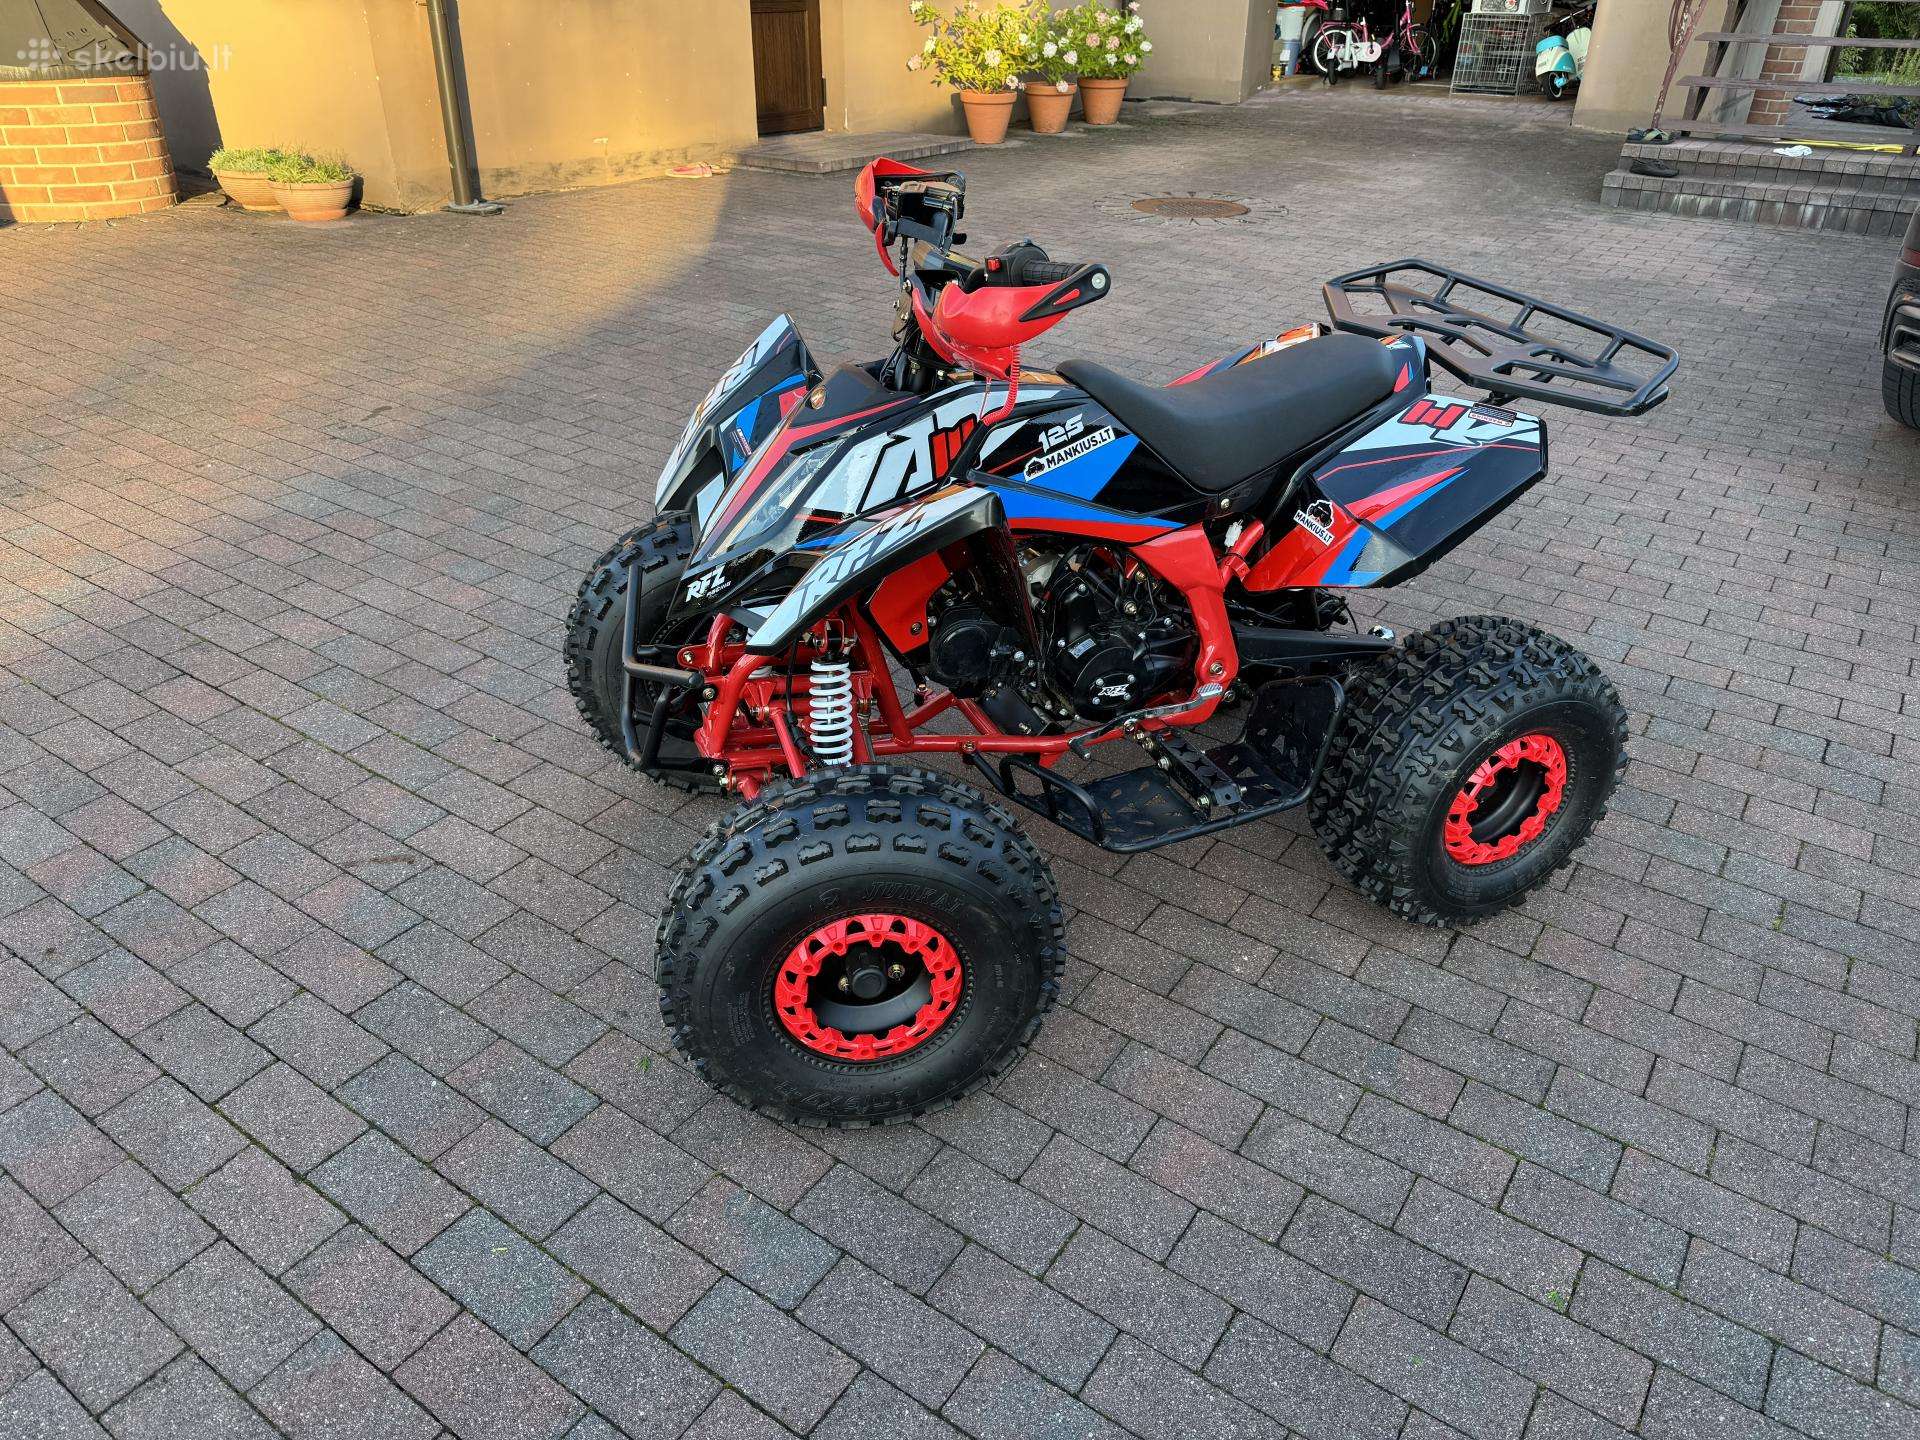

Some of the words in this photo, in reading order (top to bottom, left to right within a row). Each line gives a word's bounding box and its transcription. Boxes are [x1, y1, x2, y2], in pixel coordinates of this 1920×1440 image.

[1038, 412, 1084, 453] 125
[1045, 429, 1114, 469] MANKIUS.LT
[1295, 512, 1332, 544] MANKIUS.LT
[685, 566, 725, 602] RFZ
[1098, 683, 1129, 697] RFZ
